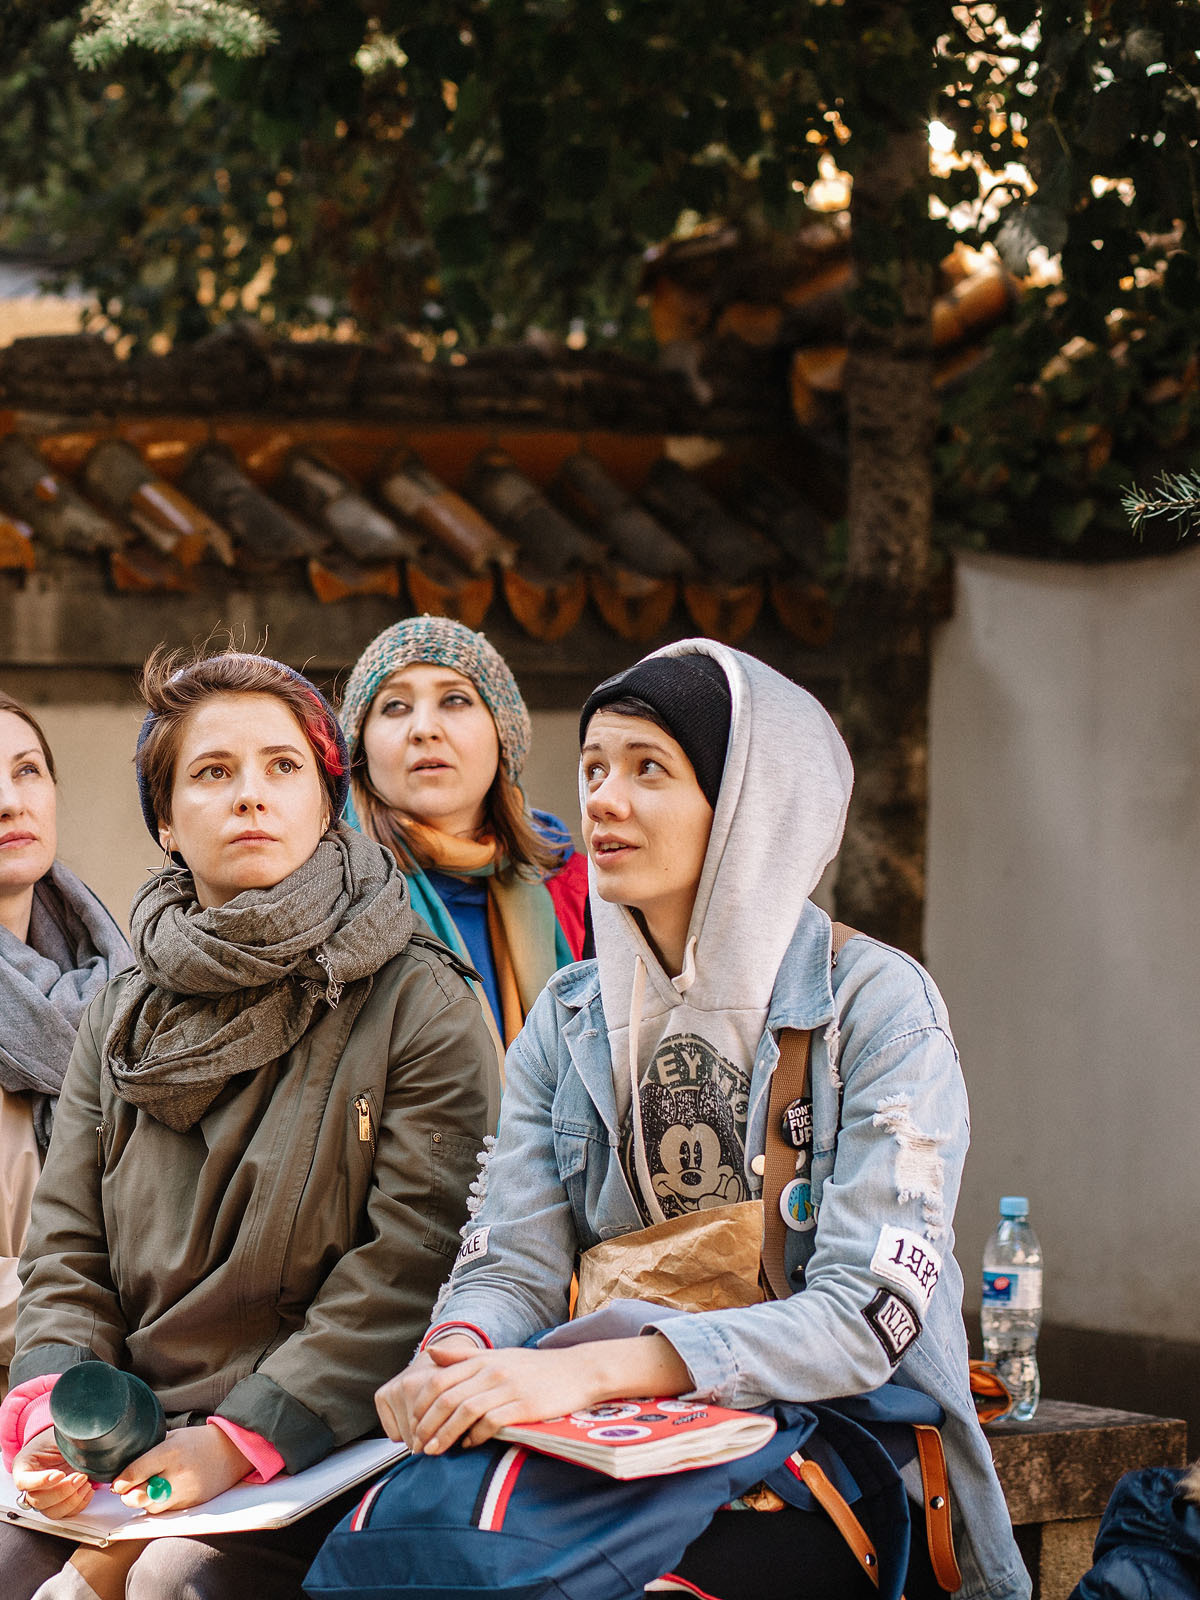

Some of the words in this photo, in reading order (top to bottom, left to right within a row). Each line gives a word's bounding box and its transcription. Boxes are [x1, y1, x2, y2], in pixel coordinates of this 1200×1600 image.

[788, 1103, 813, 1119] DON'
[789, 1115, 812, 1131] FUC
[888, 1238, 938, 1299] 1987
